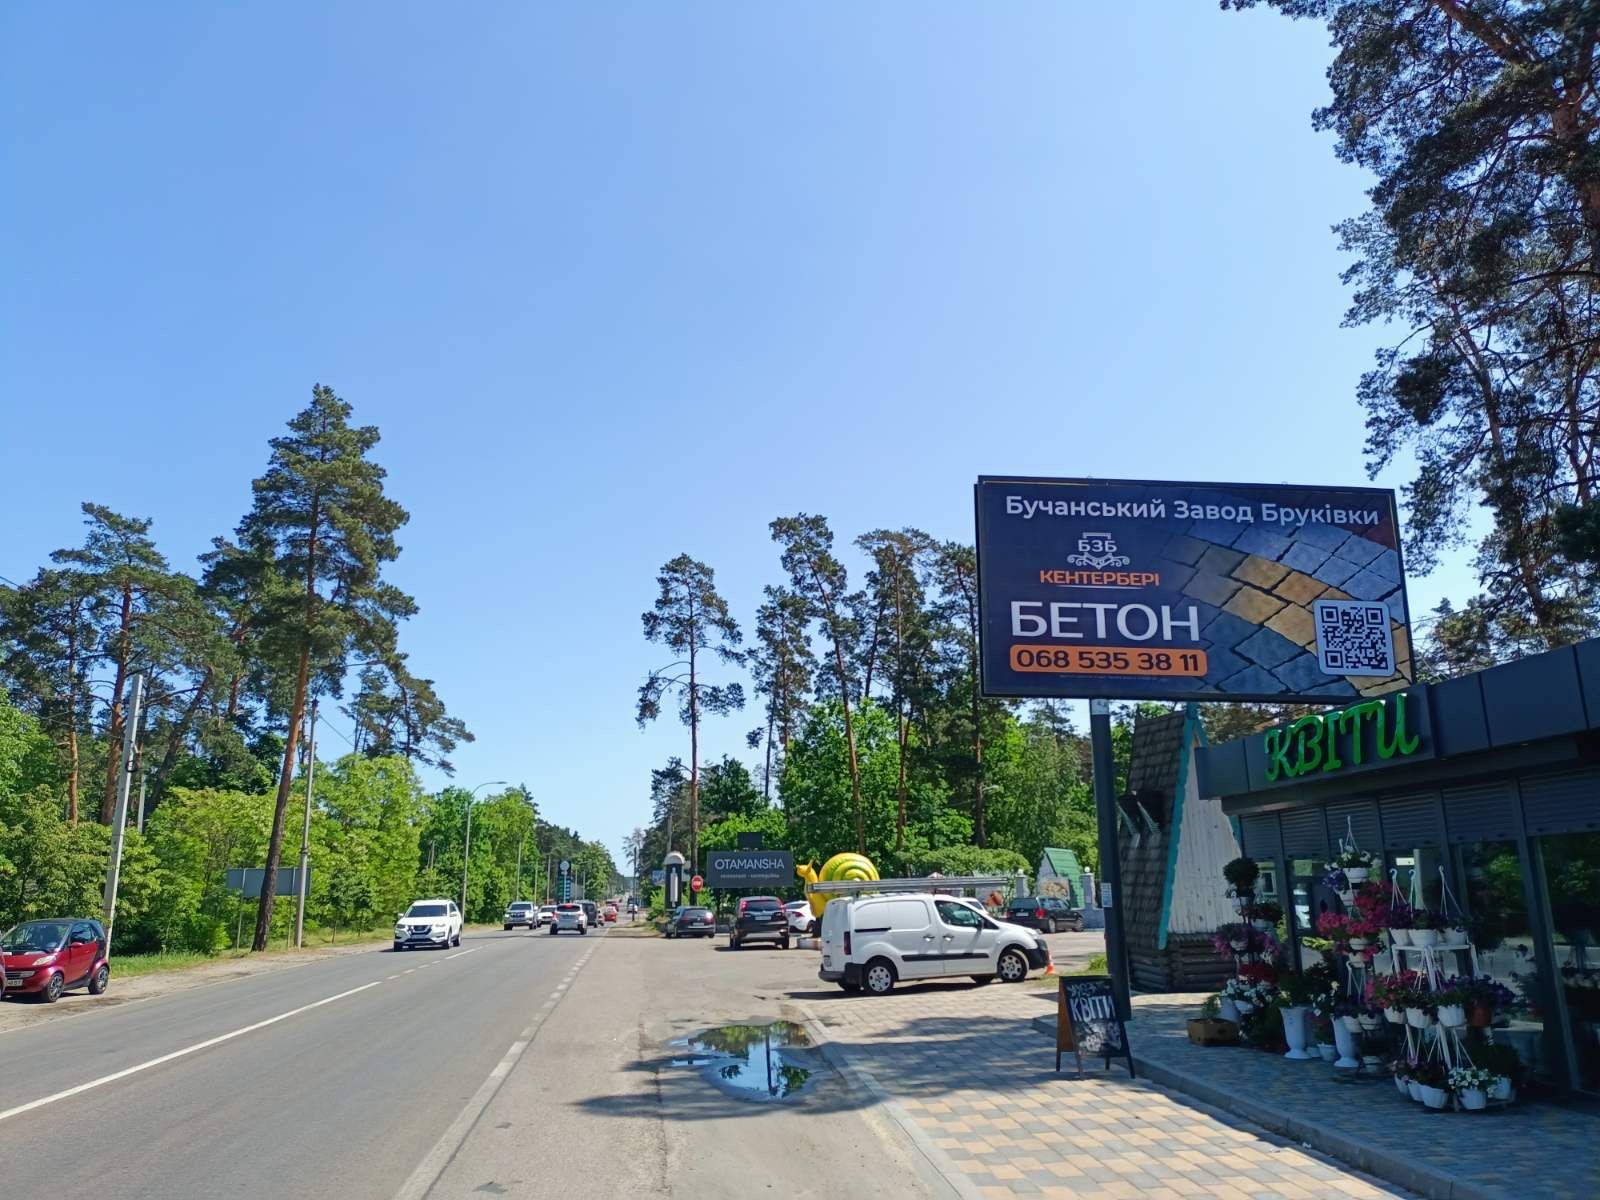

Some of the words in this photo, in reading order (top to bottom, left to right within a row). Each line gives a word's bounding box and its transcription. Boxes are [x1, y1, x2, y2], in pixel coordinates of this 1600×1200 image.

[1005, 495, 1166, 519] Бучанський
[1173, 500, 1254, 523] Завод
[1260, 503, 1380, 526] Бруківки
[1077, 539, 1118, 553] БЗБ
[1039, 570, 1160, 586] КЕНТЕРБЕРІ
[1010, 600, 1200, 642] БЕТОН
[1016, 649, 1070, 668] 068
[1078, 651, 1130, 670] 535
[1137, 652, 1173, 671] 38
[1179, 653, 1199, 672] 11
[1263, 692, 1420, 781] КВІТИ
[714, 858, 785, 870] OTAMANSHA
[1069, 995, 1116, 1022] КВІТИ
